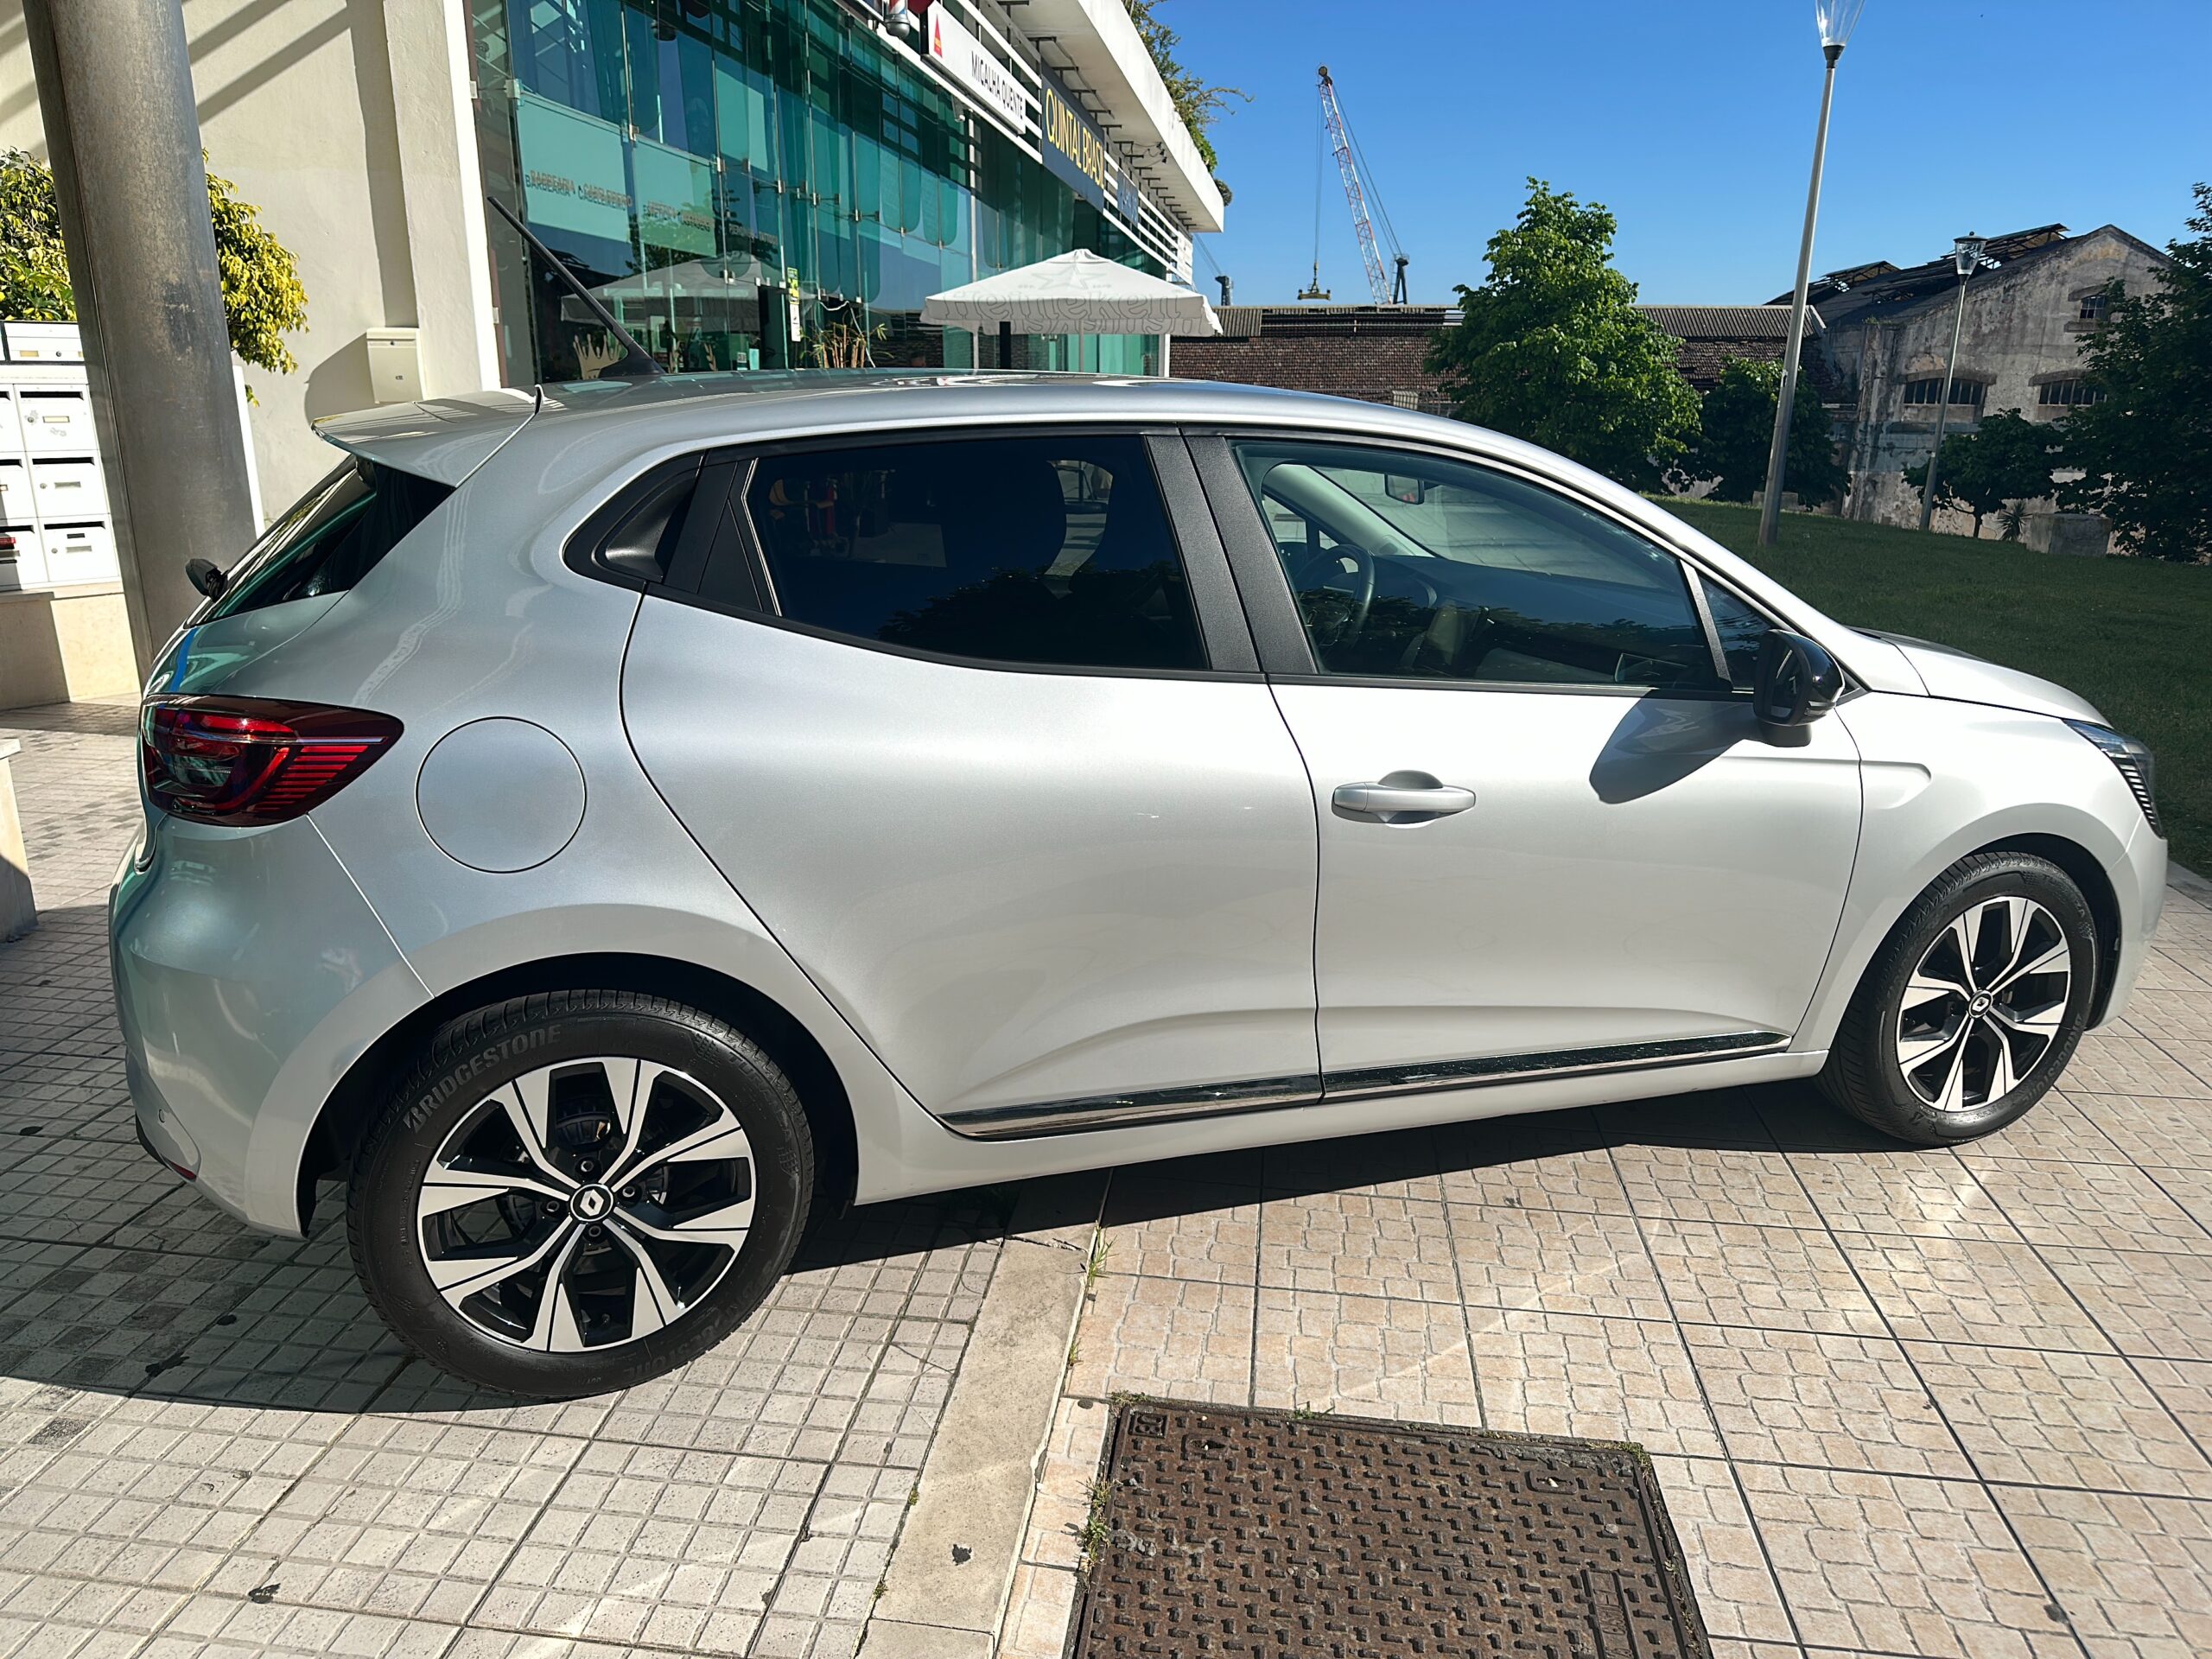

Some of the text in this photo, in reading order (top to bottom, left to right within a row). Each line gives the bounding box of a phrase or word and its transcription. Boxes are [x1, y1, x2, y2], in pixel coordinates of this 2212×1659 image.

[1001, 79, 1023, 120] QUENTE
[1045, 87, 1105, 189] QUINTAL BRASIL
[403, 1024, 561, 1134] BRIDGESTONE
